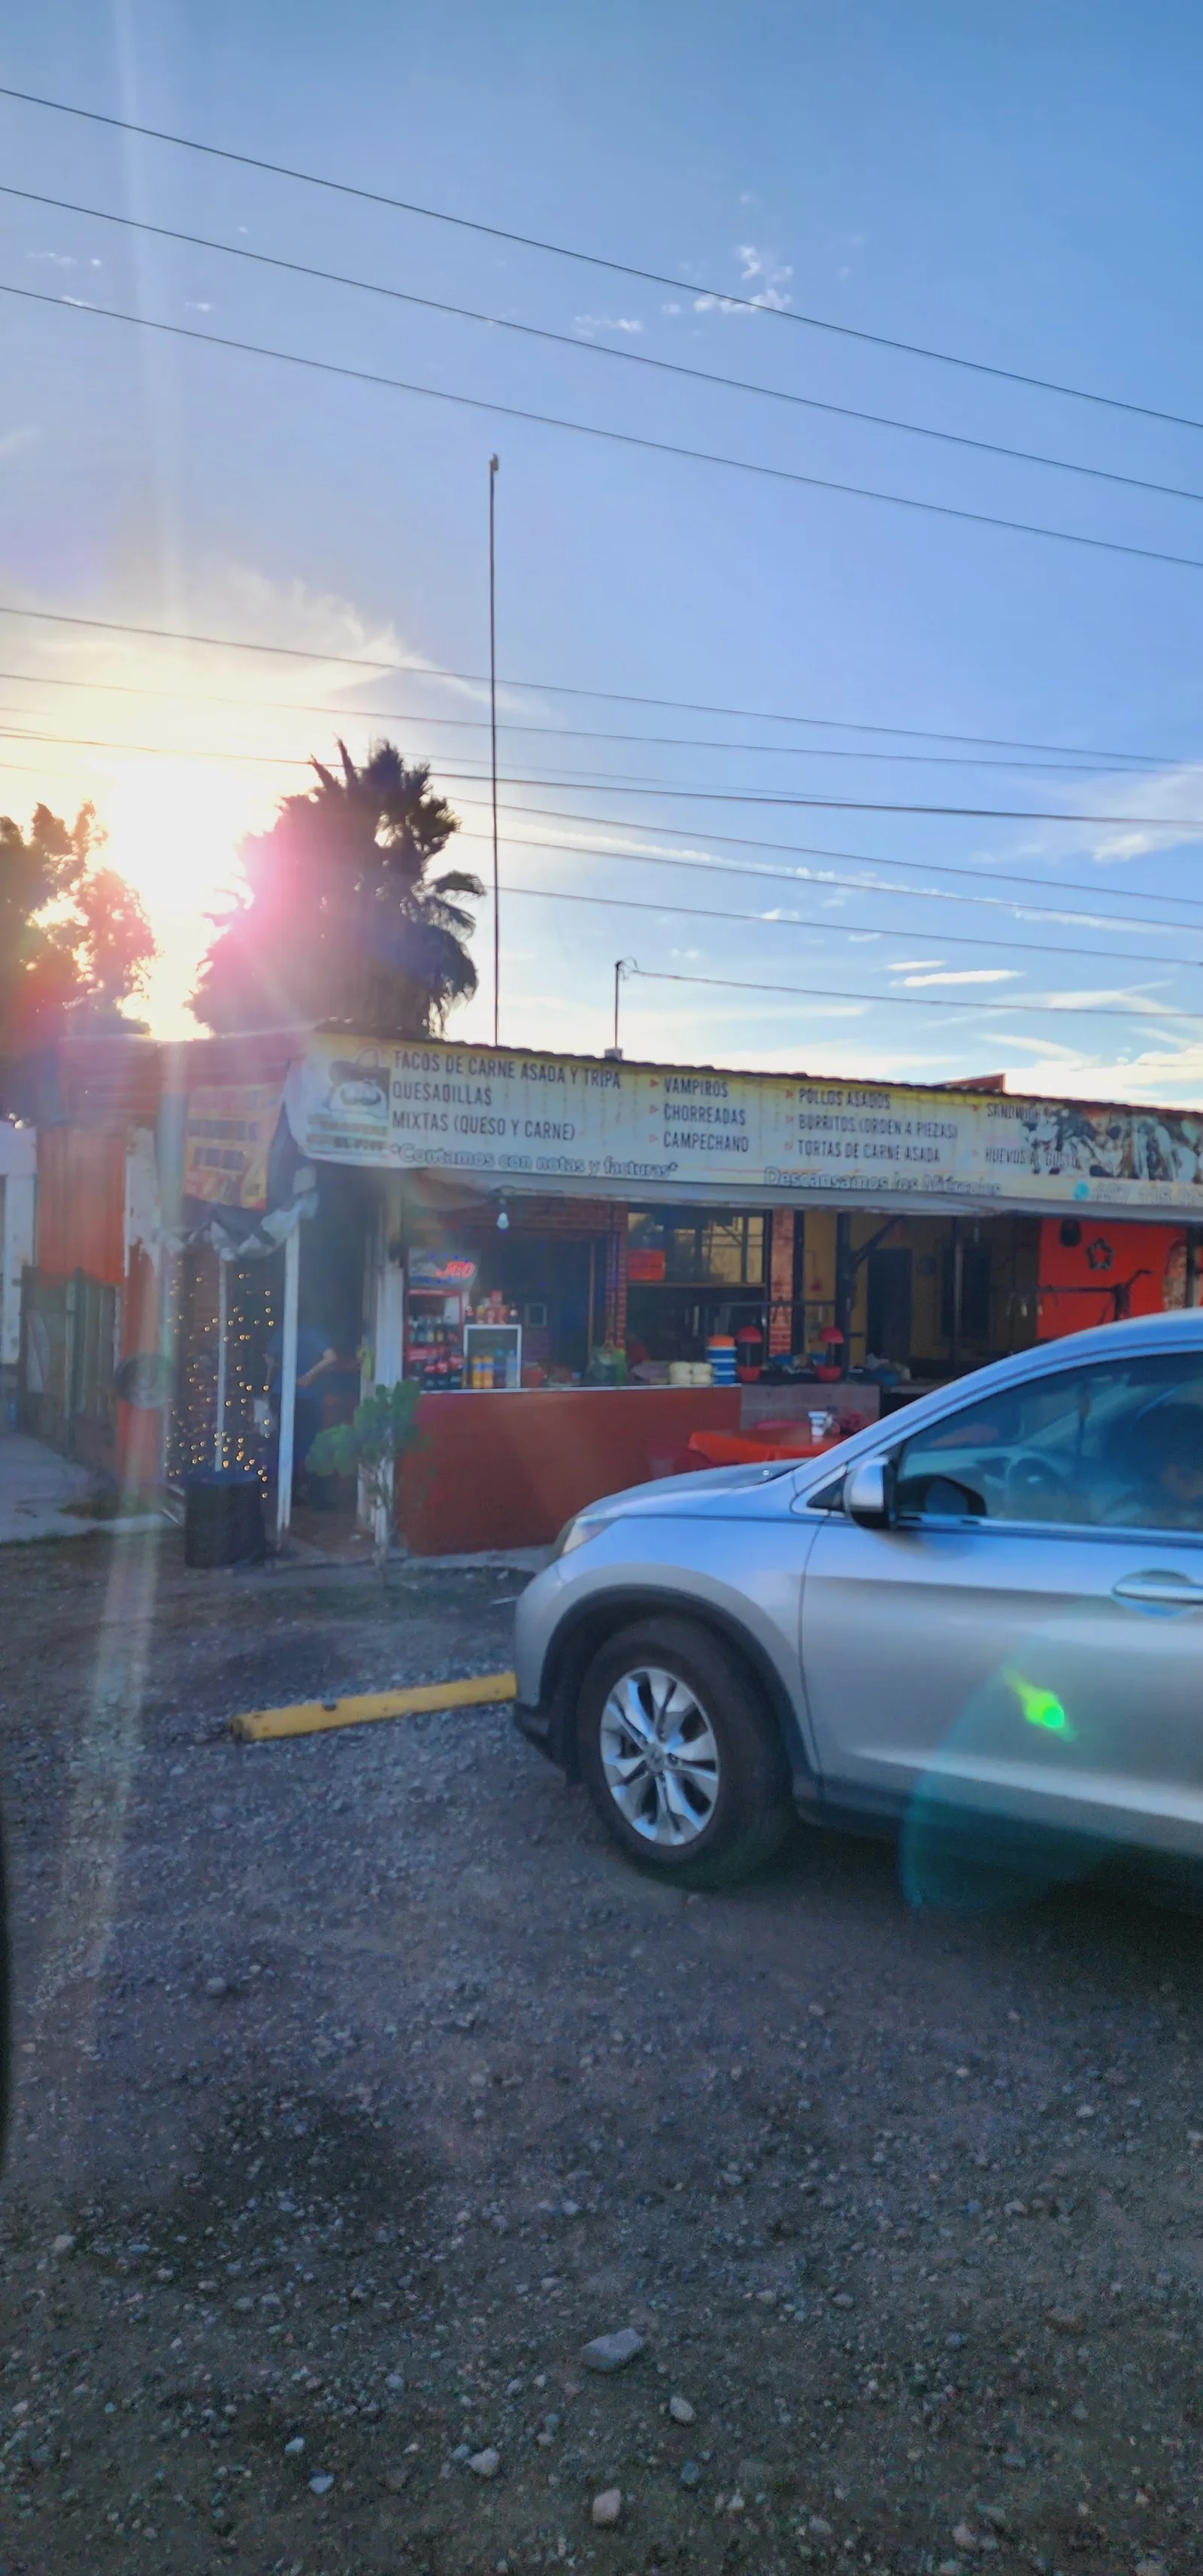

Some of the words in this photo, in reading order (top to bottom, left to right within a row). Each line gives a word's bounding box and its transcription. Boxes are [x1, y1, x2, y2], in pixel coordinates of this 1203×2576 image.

[393, 1050, 440, 1071] TACOS
[445, 1055, 463, 1074] DE
[468, 1057, 515, 1079] CARNE
[520, 1062, 565, 1083] ASADA
[570, 1065, 577, 1085] Y
[583, 1066, 621, 1089] TRIPA
[392, 1080, 492, 1106] QUESADILLAS
[663, 1077, 729, 1098] VAMPIROS
[798, 1087, 843, 1106] POLLOS
[846, 1091, 891, 1110] ASADOS
[392, 1111, 448, 1132] MIXTAS
[453, 1114, 505, 1135] (QUESO
[512, 1119, 520, 1136] Y
[526, 1120, 575, 1141] CARNE)
[663, 1104, 746, 1126] CHORREADAS
[798, 1114, 856, 1132] BURRITOS
[905, 1120, 912, 1135] A
[662, 1132, 749, 1153] CAMPECHANO
[798, 1139, 841, 1158] TORTAS
[844, 1141, 859, 1159] DE
[863, 1143, 901, 1161] CARNE
[904, 1145, 941, 1163] ASADA
[498, 1153, 533, 1170] con
[536, 1156, 585, 1173] notas
[589, 1159, 601, 1178] y
[985, 1147, 1026, 1164] HUEVOS
[764, 1165, 889, 1190] Descansamos
